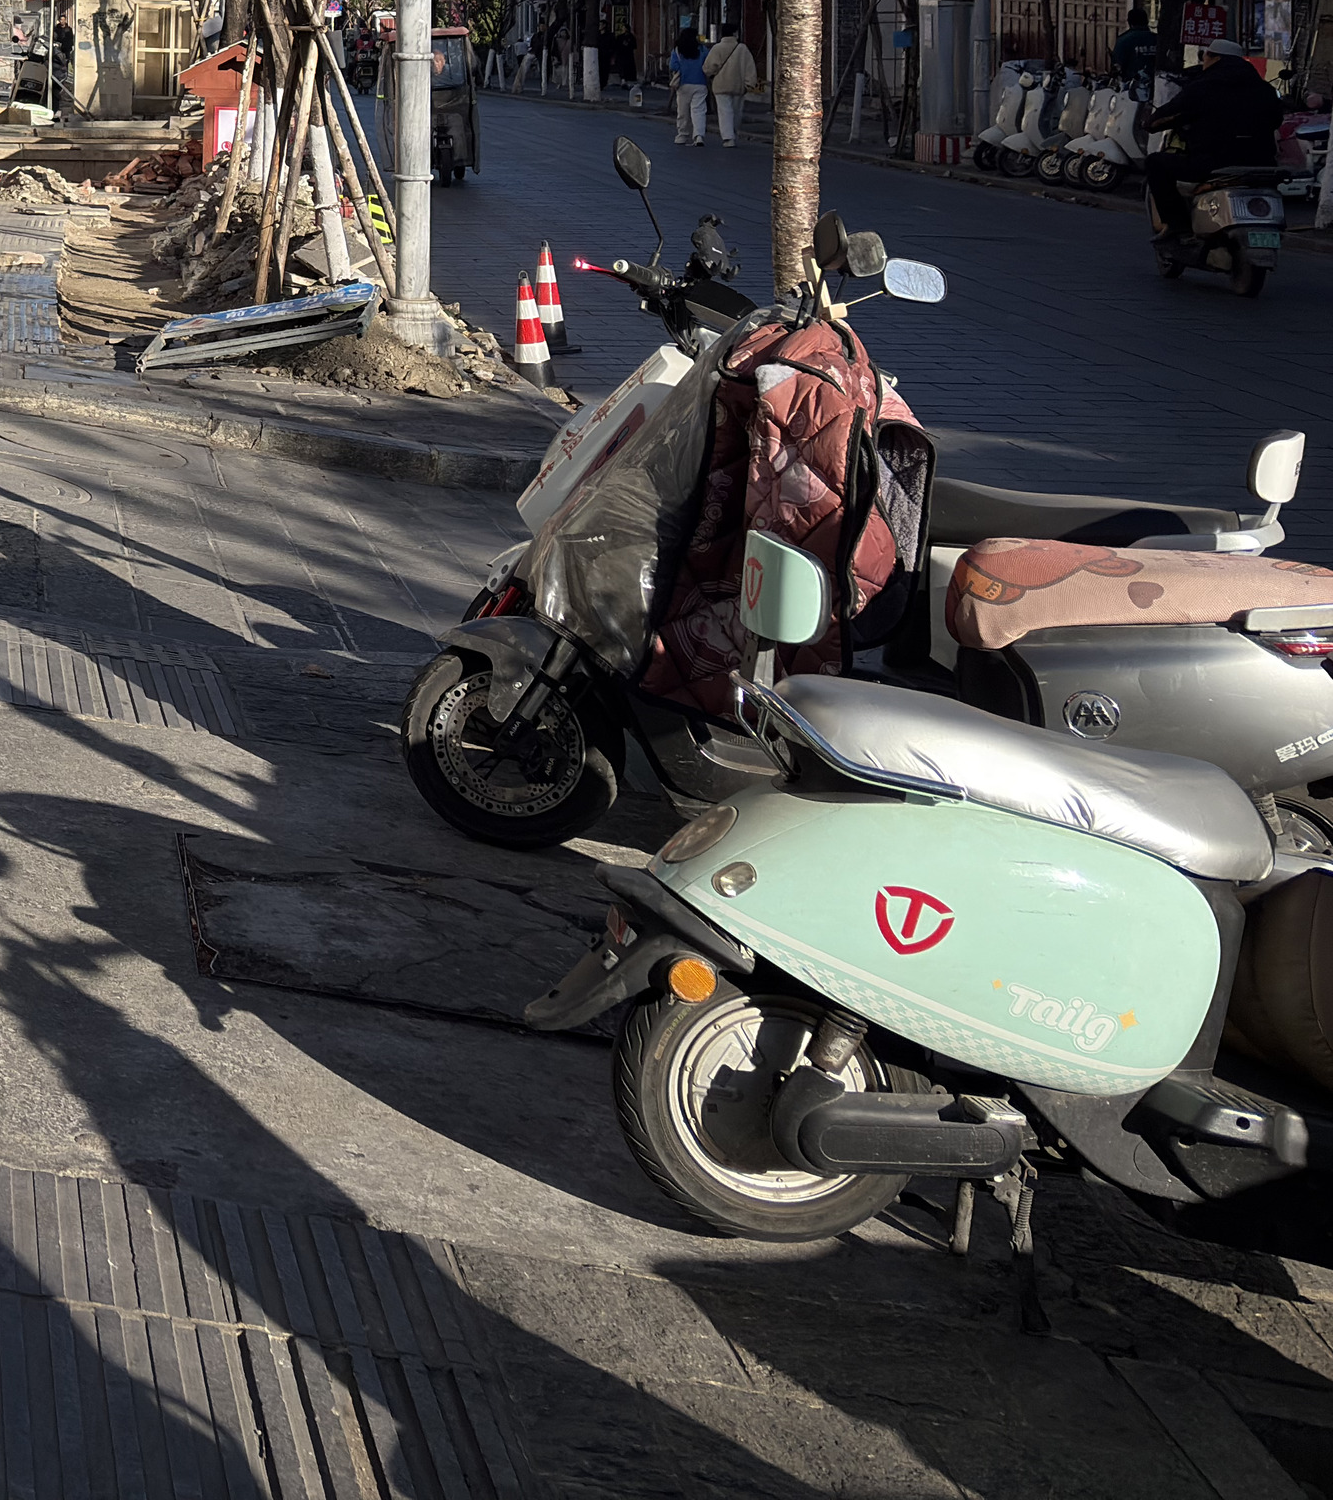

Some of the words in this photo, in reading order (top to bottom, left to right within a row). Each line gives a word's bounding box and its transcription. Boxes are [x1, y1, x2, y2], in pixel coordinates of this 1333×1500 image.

[1184, 17, 1224, 38] 电动车
[1275, 736, 1320, 763] 爱玛
[1007, 982, 1119, 1054] Tailg
